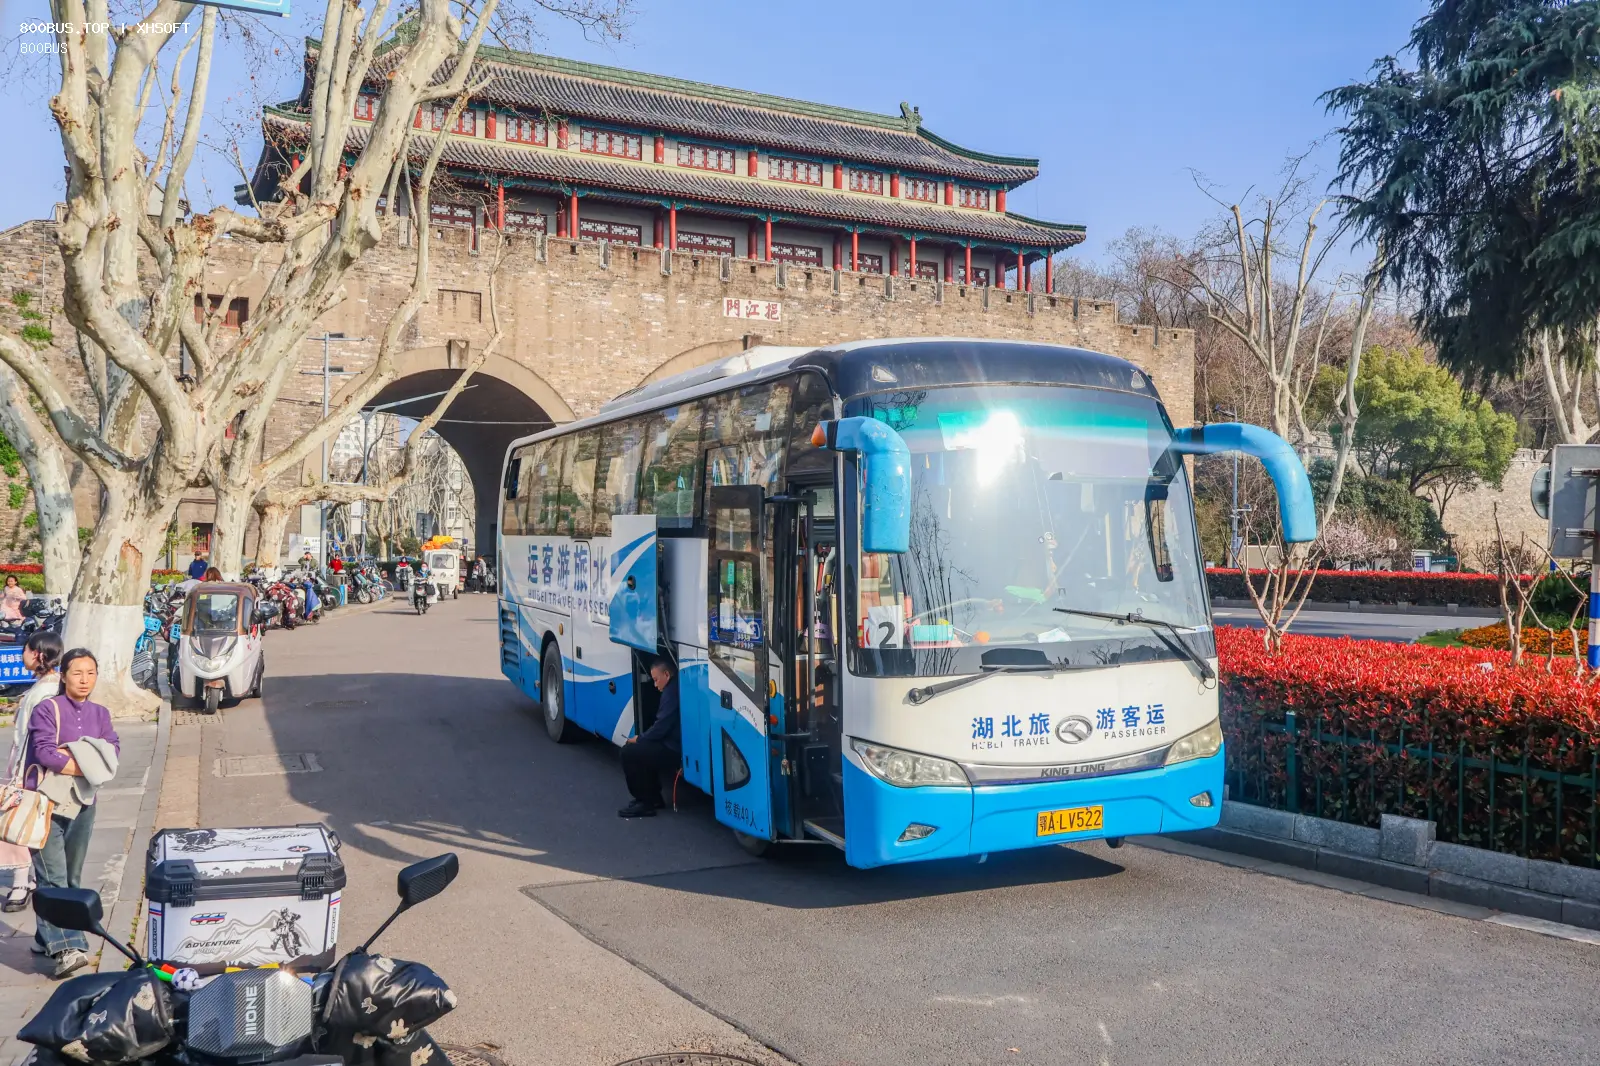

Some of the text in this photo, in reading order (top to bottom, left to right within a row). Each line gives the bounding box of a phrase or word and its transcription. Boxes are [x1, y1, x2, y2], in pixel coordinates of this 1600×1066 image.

[548, 592, 576, 610] TRAVEL
[878, 621, 897, 648] 2
[971, 703, 1166, 740] 湖北旅 游客运
[1013, 737, 1051, 748] TRAVEL
[1104, 726, 1166, 740] PASSENGER
[1041, 763, 1106, 778] KING LONG
[185, 939, 242, 949] ADVENTURE
